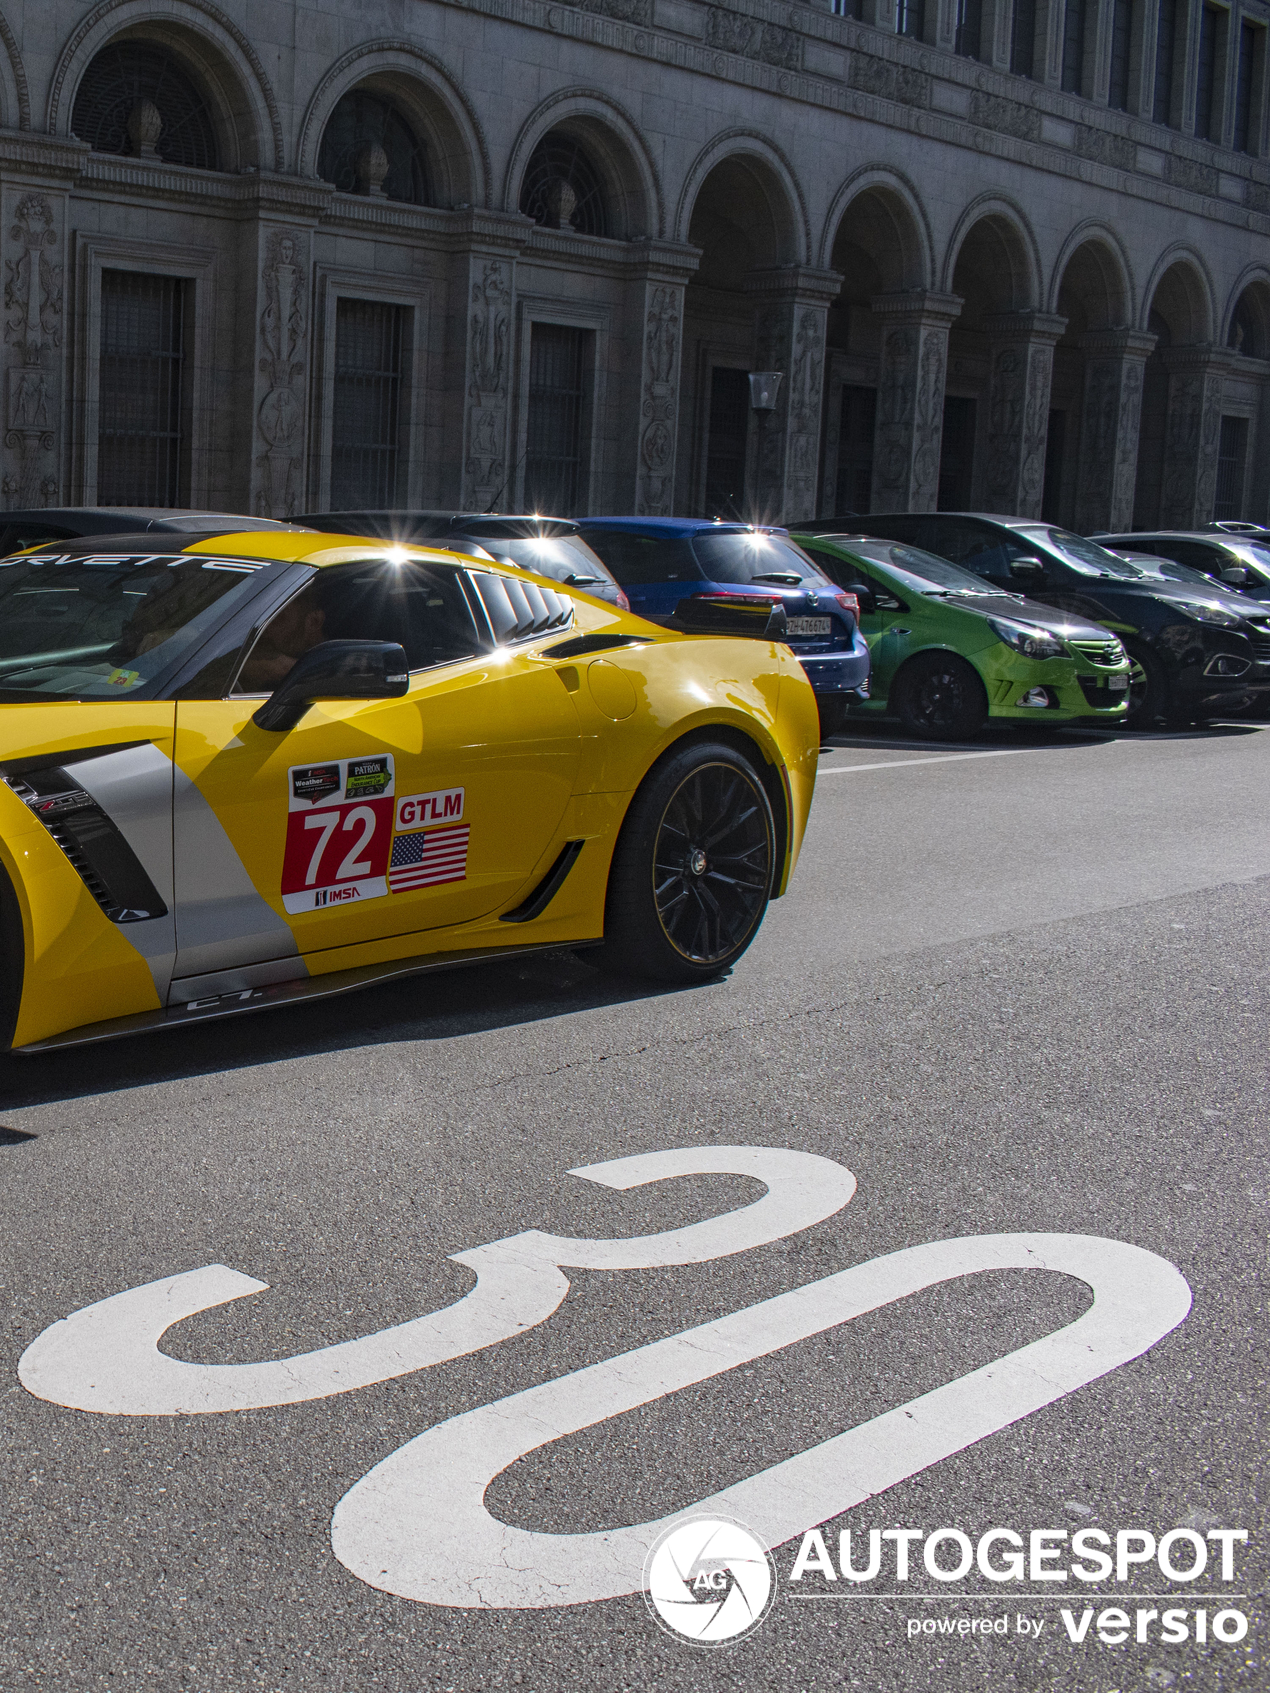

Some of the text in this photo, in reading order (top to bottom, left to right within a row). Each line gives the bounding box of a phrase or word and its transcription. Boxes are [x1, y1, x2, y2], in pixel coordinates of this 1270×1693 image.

[400, 793, 462, 825] GTLM
[304, 805, 376, 886] 72
[329, 886, 361, 902] IMSA
[17, 1146, 1193, 1609] 30
